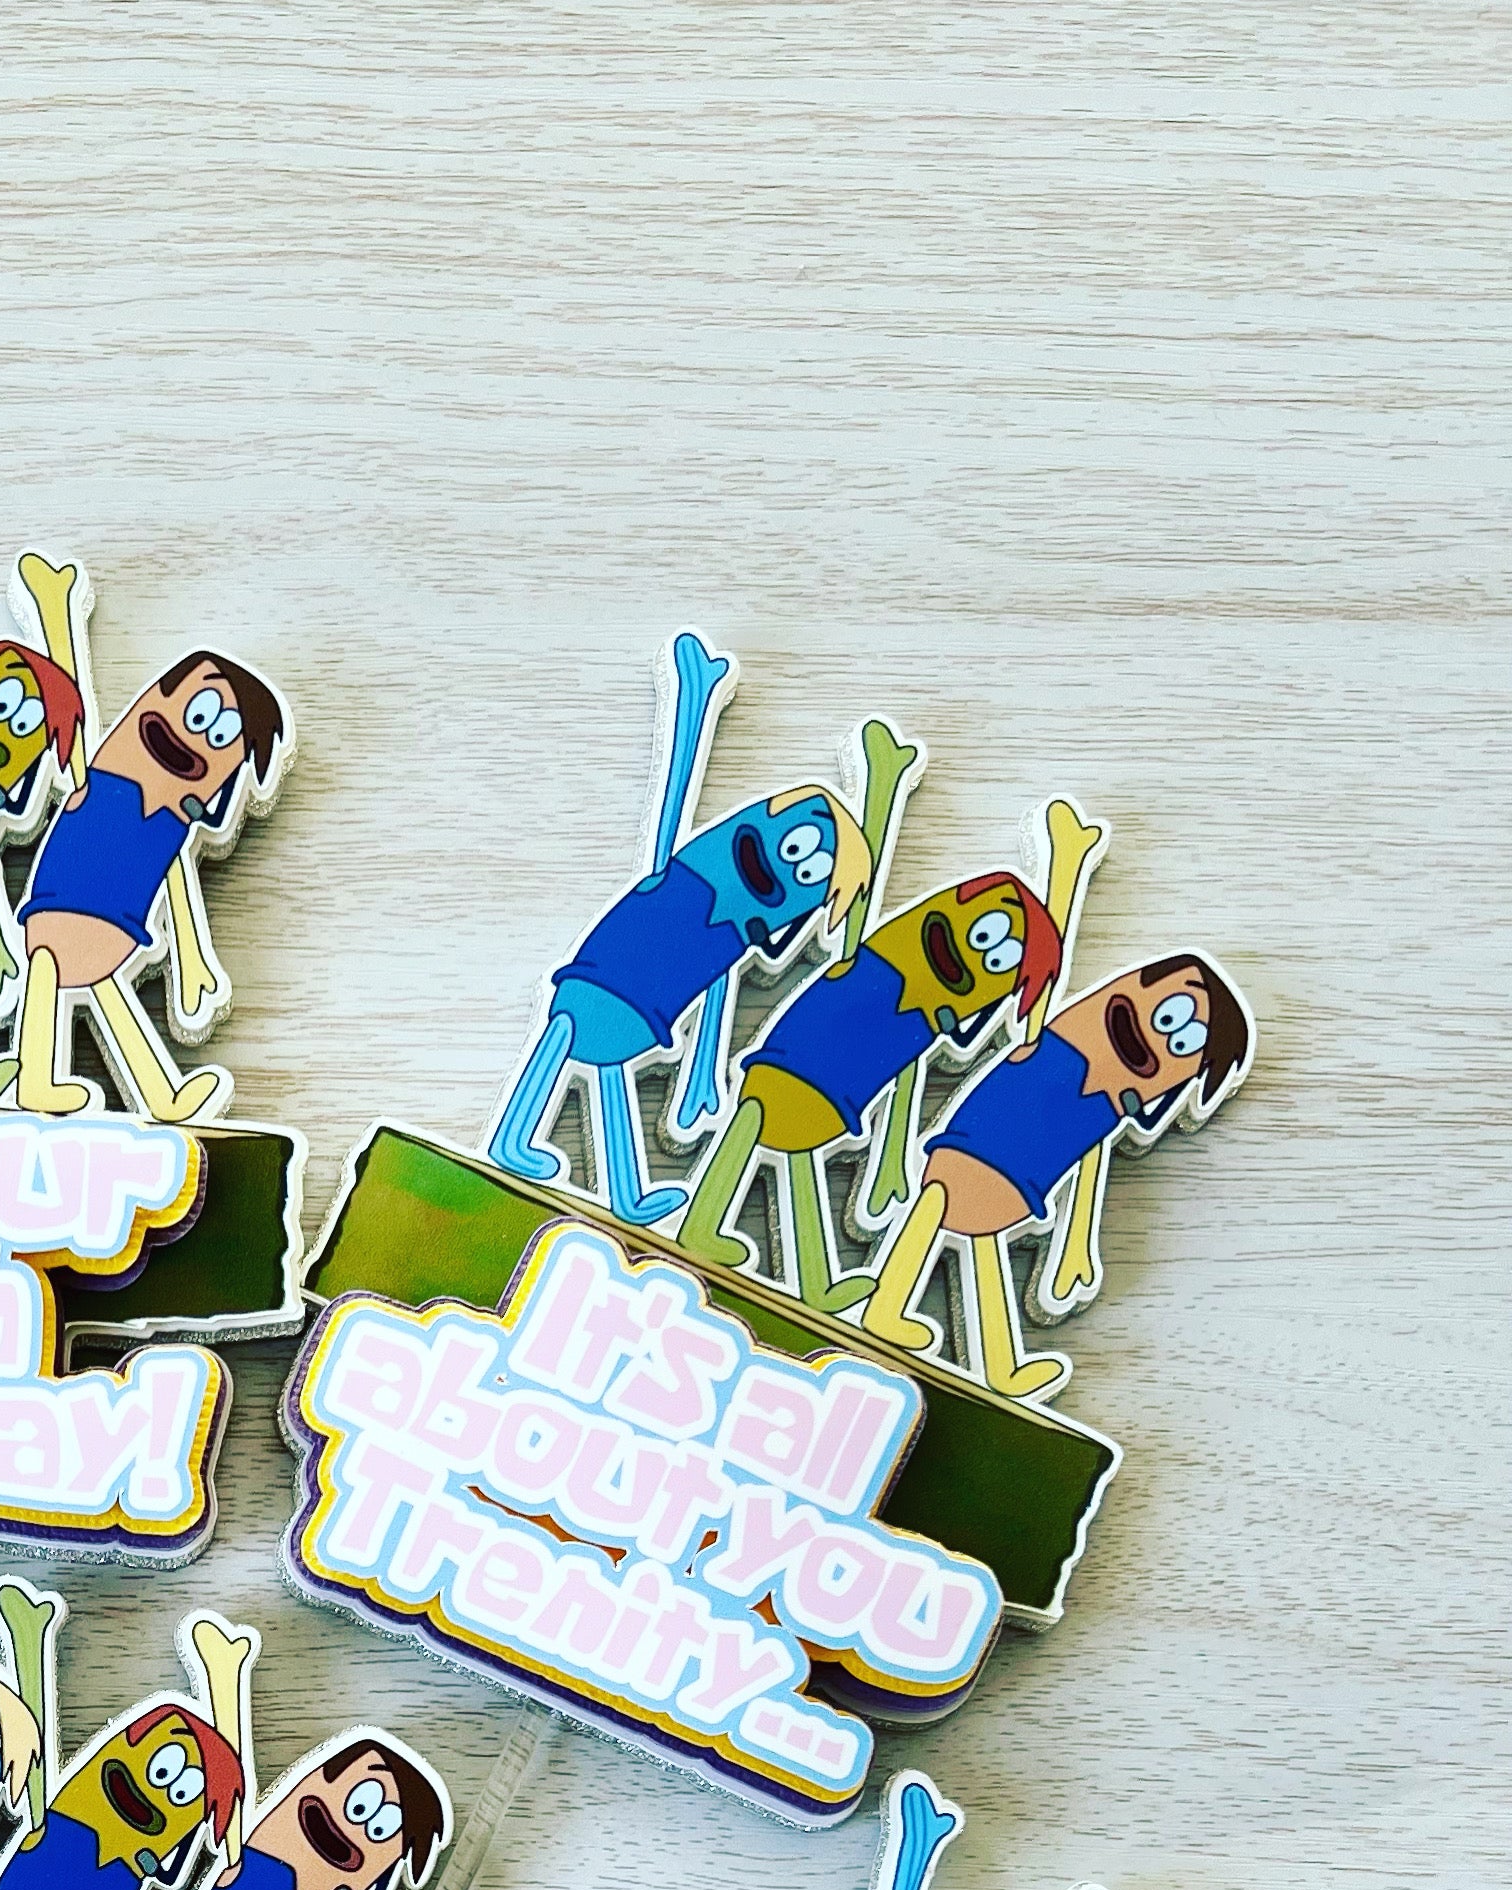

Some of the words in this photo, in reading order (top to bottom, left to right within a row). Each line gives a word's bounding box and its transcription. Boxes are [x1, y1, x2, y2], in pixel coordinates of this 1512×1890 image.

[332, 1330, 724, 1558] about
[714, 1495, 982, 1661] you
[524, 1255, 726, 1424] It's
[731, 1374, 898, 1501] all
[334, 1451, 848, 1765] Trenity...
